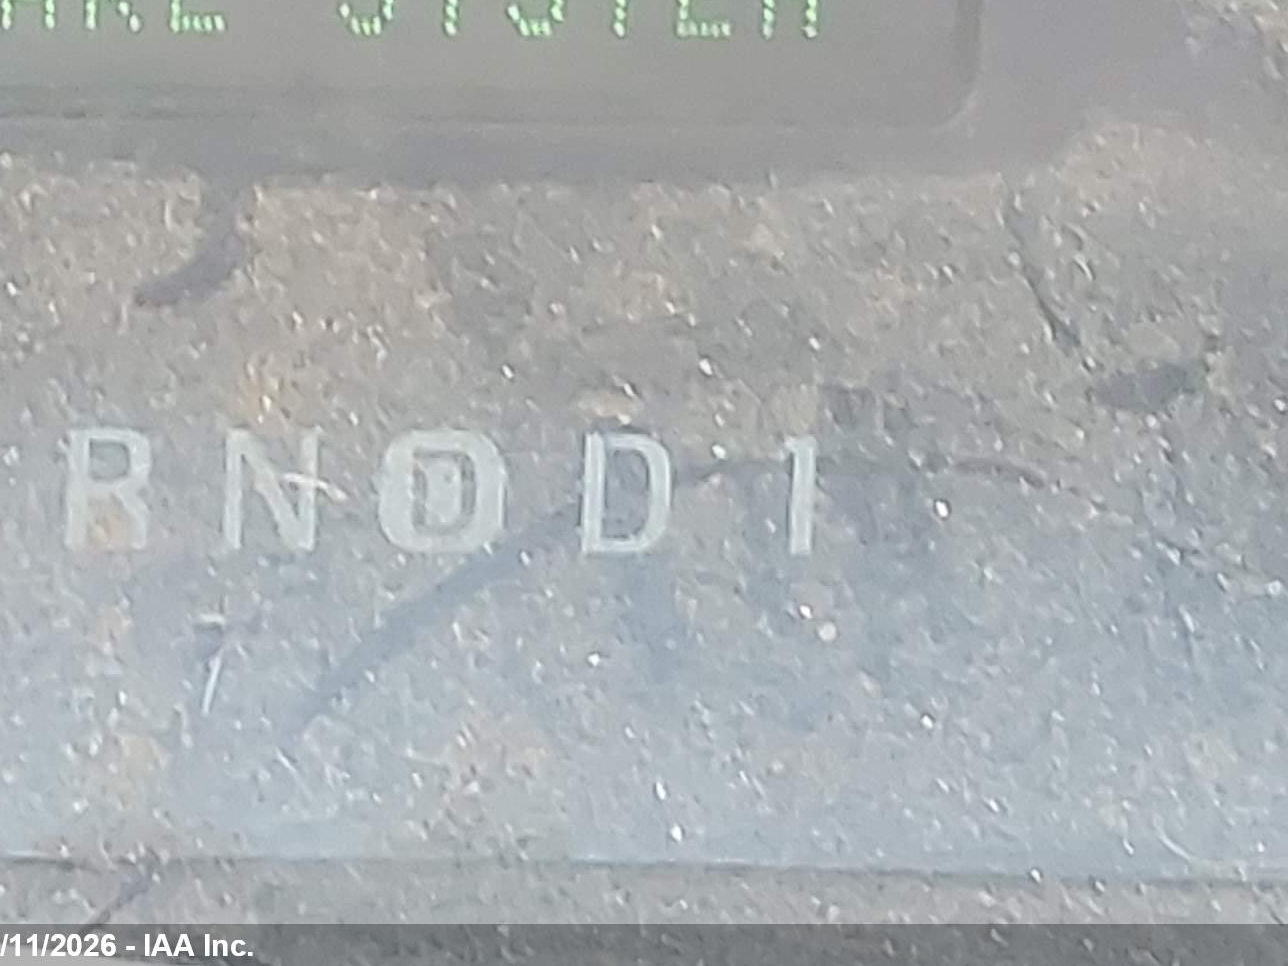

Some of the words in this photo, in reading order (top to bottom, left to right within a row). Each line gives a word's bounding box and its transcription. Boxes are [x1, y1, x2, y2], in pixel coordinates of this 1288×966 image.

[64, 427, 153, 549] R
[221, 428, 320, 551] N
[581, 430, 673, 554] D
